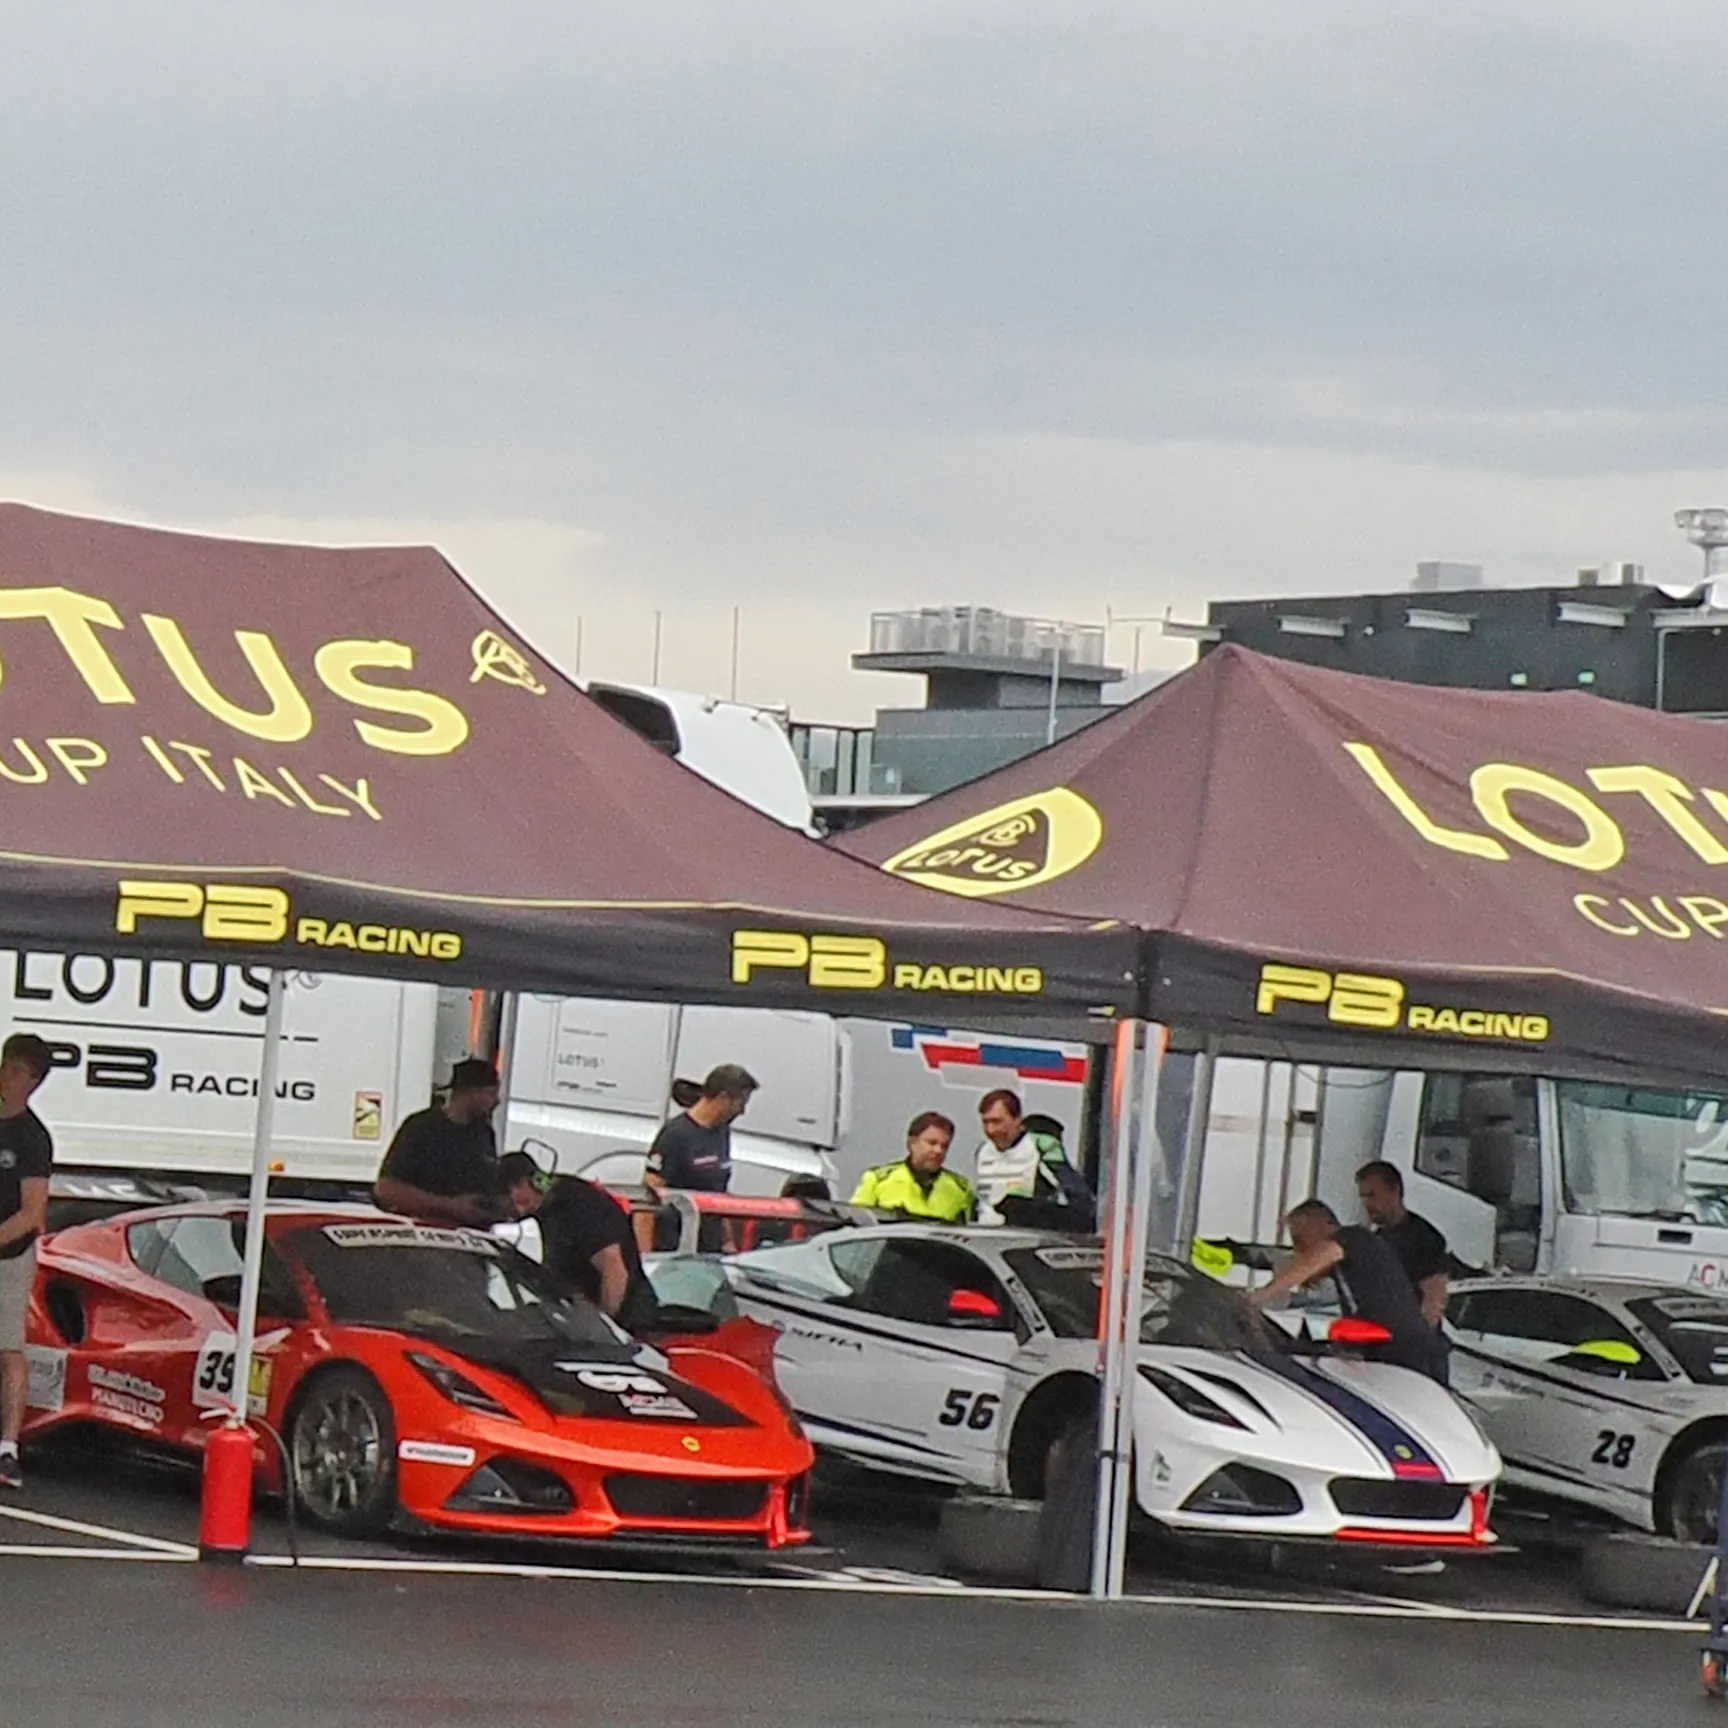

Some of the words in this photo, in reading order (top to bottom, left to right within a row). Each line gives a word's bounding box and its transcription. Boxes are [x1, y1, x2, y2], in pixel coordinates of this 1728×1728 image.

[142, 735, 383, 822] ITALY
[901, 847, 1038, 879] LOTUS
[116, 878, 290, 943] PB
[296, 917, 462, 959] RACING
[731, 930, 887, 990] PB
[893, 964, 1043, 993] RACING
[1256, 964, 1405, 1029] PB
[1407, 1004, 1549, 1041] RACING
[938, 1387, 1001, 1430] 56
[1591, 1429, 1636, 1469] 28
